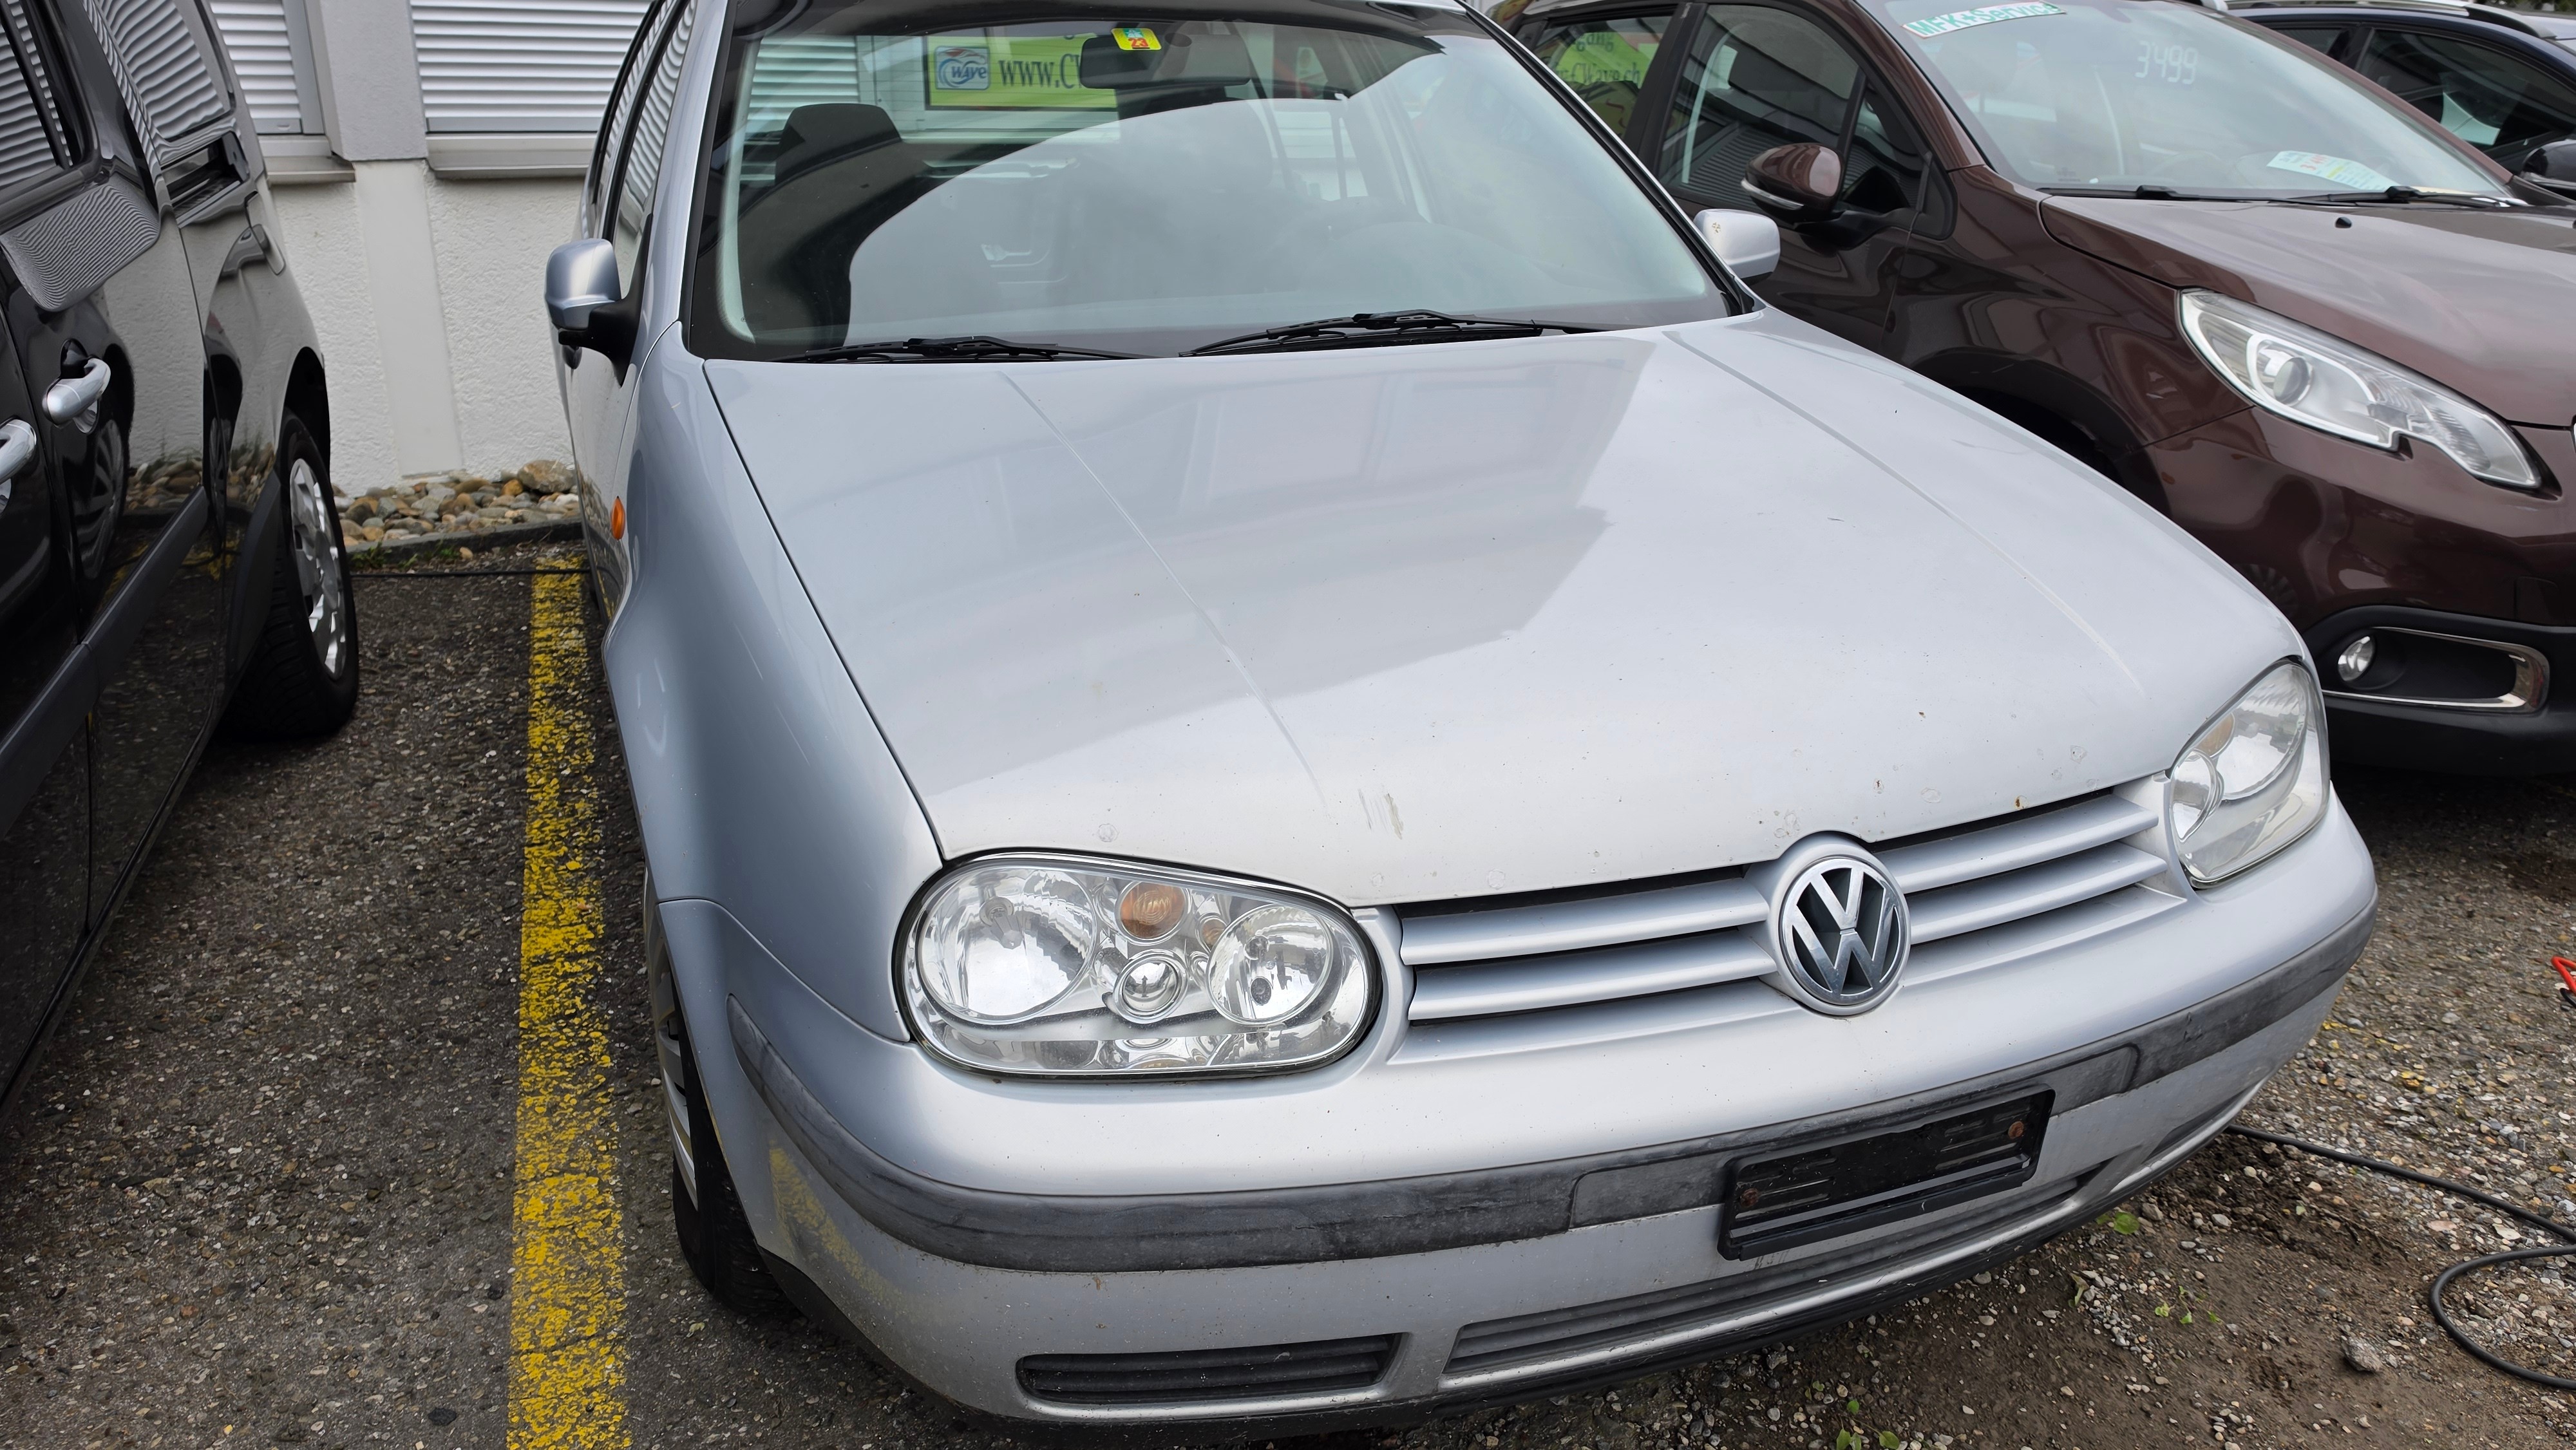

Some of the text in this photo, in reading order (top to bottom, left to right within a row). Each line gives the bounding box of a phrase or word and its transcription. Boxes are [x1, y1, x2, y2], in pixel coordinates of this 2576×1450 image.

[1907, 3, 2060, 35] MFK+Service
[1128, 37, 1149, 47] 23
[1577, 32, 1615, 52] gang
[998, 53, 1081, 89] www.C
[1783, 860, 1902, 1005] VW
